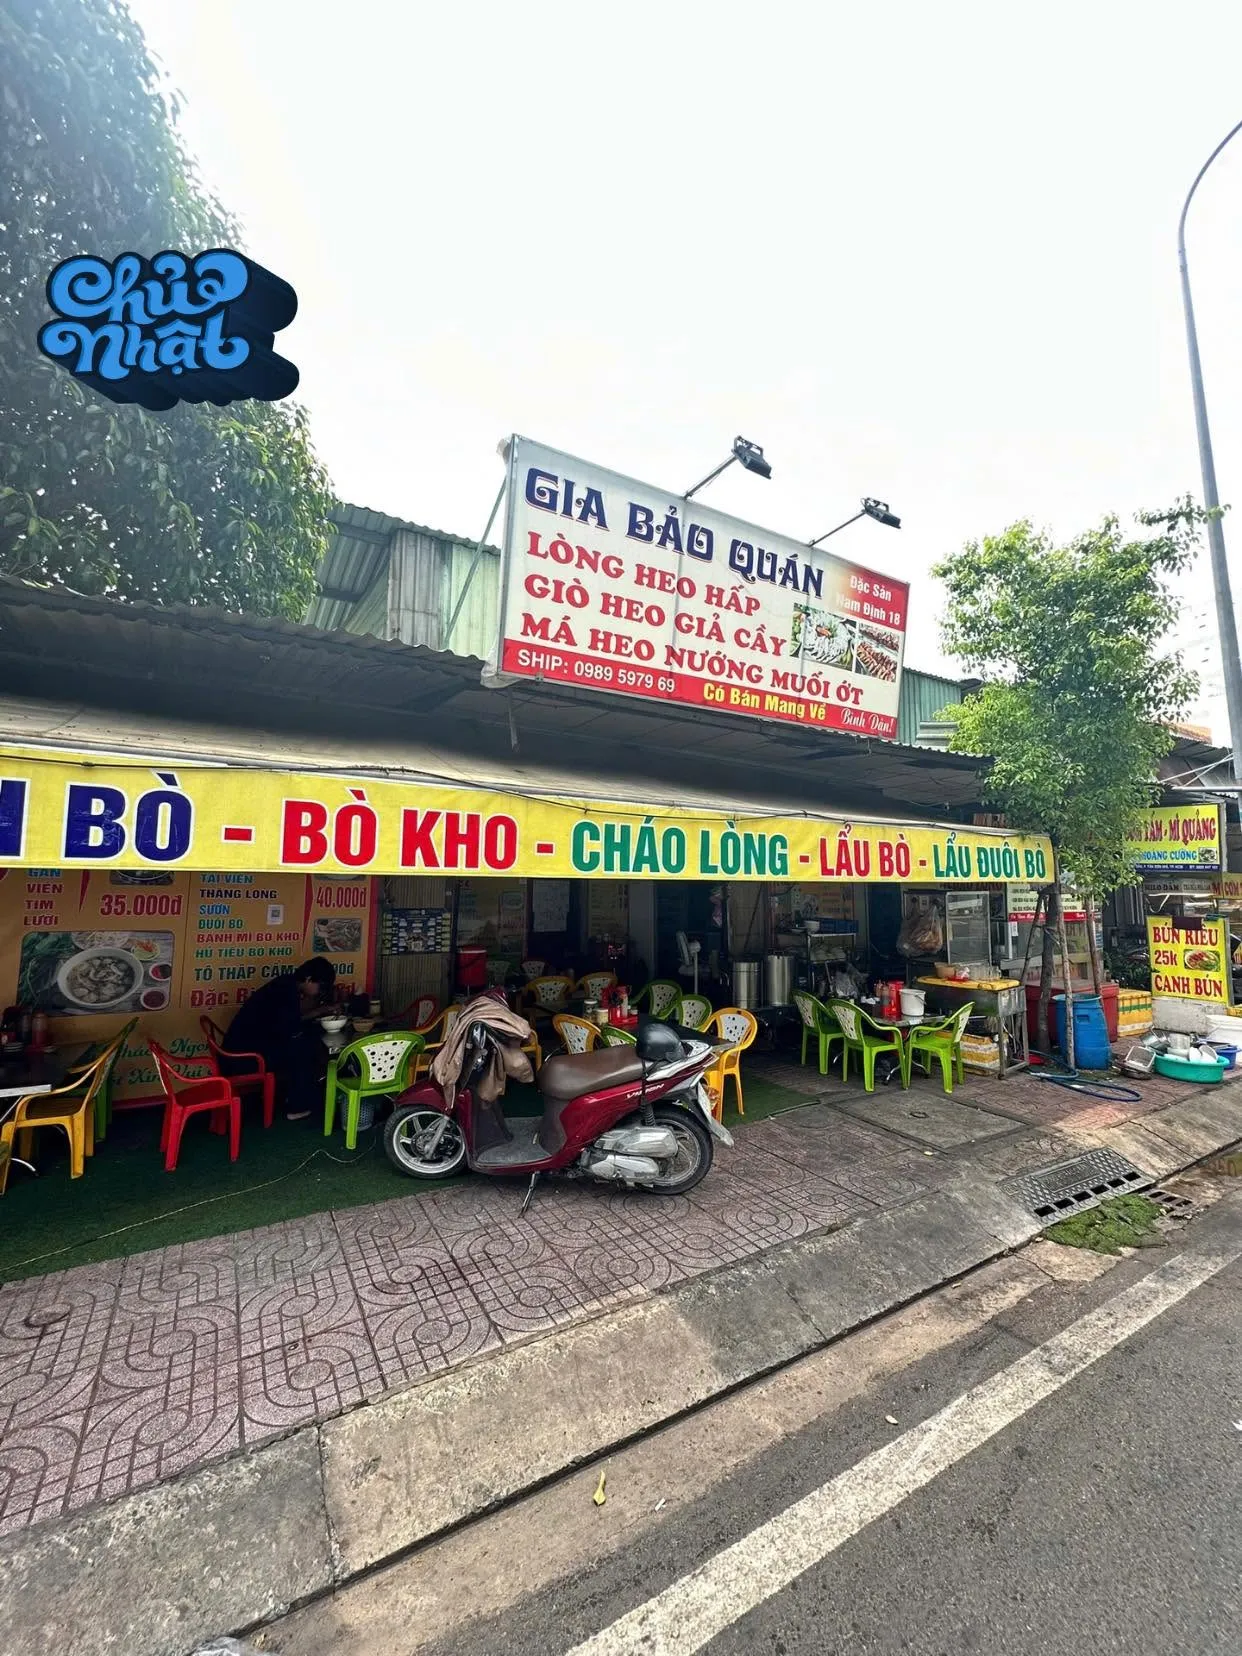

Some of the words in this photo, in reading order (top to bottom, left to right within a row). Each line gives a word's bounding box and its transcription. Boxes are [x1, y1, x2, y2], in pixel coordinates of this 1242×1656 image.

[525, 467, 610, 532] GIA
[626, 501, 714, 564] BẢO
[729, 538, 824, 599] QUÁN
[527, 531, 625, 579] LÒNG
[634, 563, 697, 599] HEO
[704, 584, 760, 616] HẤP
[850, 575, 870, 595] Đặc
[872, 583, 892, 602] Sản
[524, 573, 590, 609] GIÒ
[600, 592, 666, 627] HEO
[674, 612, 726, 643] GIẢ
[733, 623, 788, 657] CẦY
[836, 591, 861, 613] Nam
[863, 601, 886, 620] Định
[888, 611, 901, 625] 18
[517, 649, 569, 674] SHIP:
[574, 660, 613, 682] 0989
[617, 669, 654, 688] 5979
[657, 676, 676, 693] 69
[520, 612, 578, 647] MÁ
[588, 628, 655, 661] HEO
[664, 645, 764, 684] NƯỚNG
[771, 669, 830, 699] MUỐI
[836, 680, 864, 705] ỚT
[703, 682, 725, 702] Có
[730, 688, 760, 709] Bán
[764, 695, 805, 719] Mang
[809, 702, 827, 721] Về
[65, 772, 192, 861] BÒ
[282, 789, 377, 868] BÒ
[401, 808, 517, 869] KHO
[572, 816, 686, 874] CHÁO
[700, 820, 789, 876] LÒNG
[819, 822, 870, 877] LẨU
[878, 833, 911, 878] BÒ
[932, 832, 972, 878] LẨU
[976, 841, 1020, 879] ĐUÔI
[1026, 842, 1046, 879] BÒ
[1181, 808, 1217, 846] QUẢNG
[24, 899, 54, 910] TIM
[100, 893, 183, 917] 35.000đ
[316, 886, 367, 909] 40.000đ
[276, 931, 300, 942] KHO
[1152, 921, 1180, 944] BÚN
[268, 946, 293, 957] KHO
[1154, 974, 1191, 995] CANH
[1194, 973, 1223, 998] BÚN
